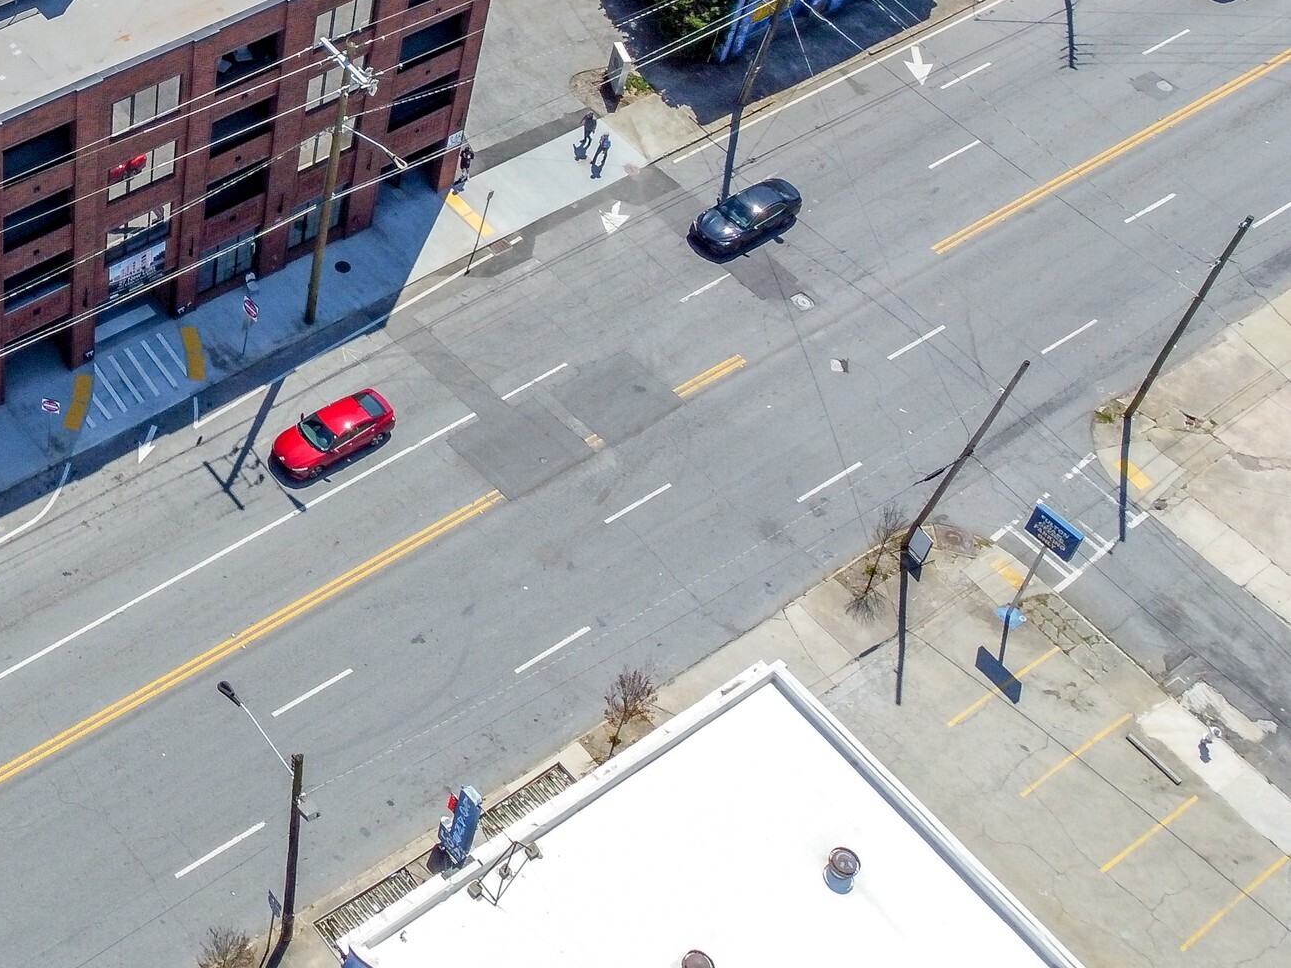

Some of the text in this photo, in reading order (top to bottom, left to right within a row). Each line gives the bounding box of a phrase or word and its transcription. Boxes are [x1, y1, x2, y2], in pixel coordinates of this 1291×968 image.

[1033, 523, 1066, 551] PARKING
[1041, 514, 1070, 539] FULTON
[1037, 533, 1056, 549] ONLY
